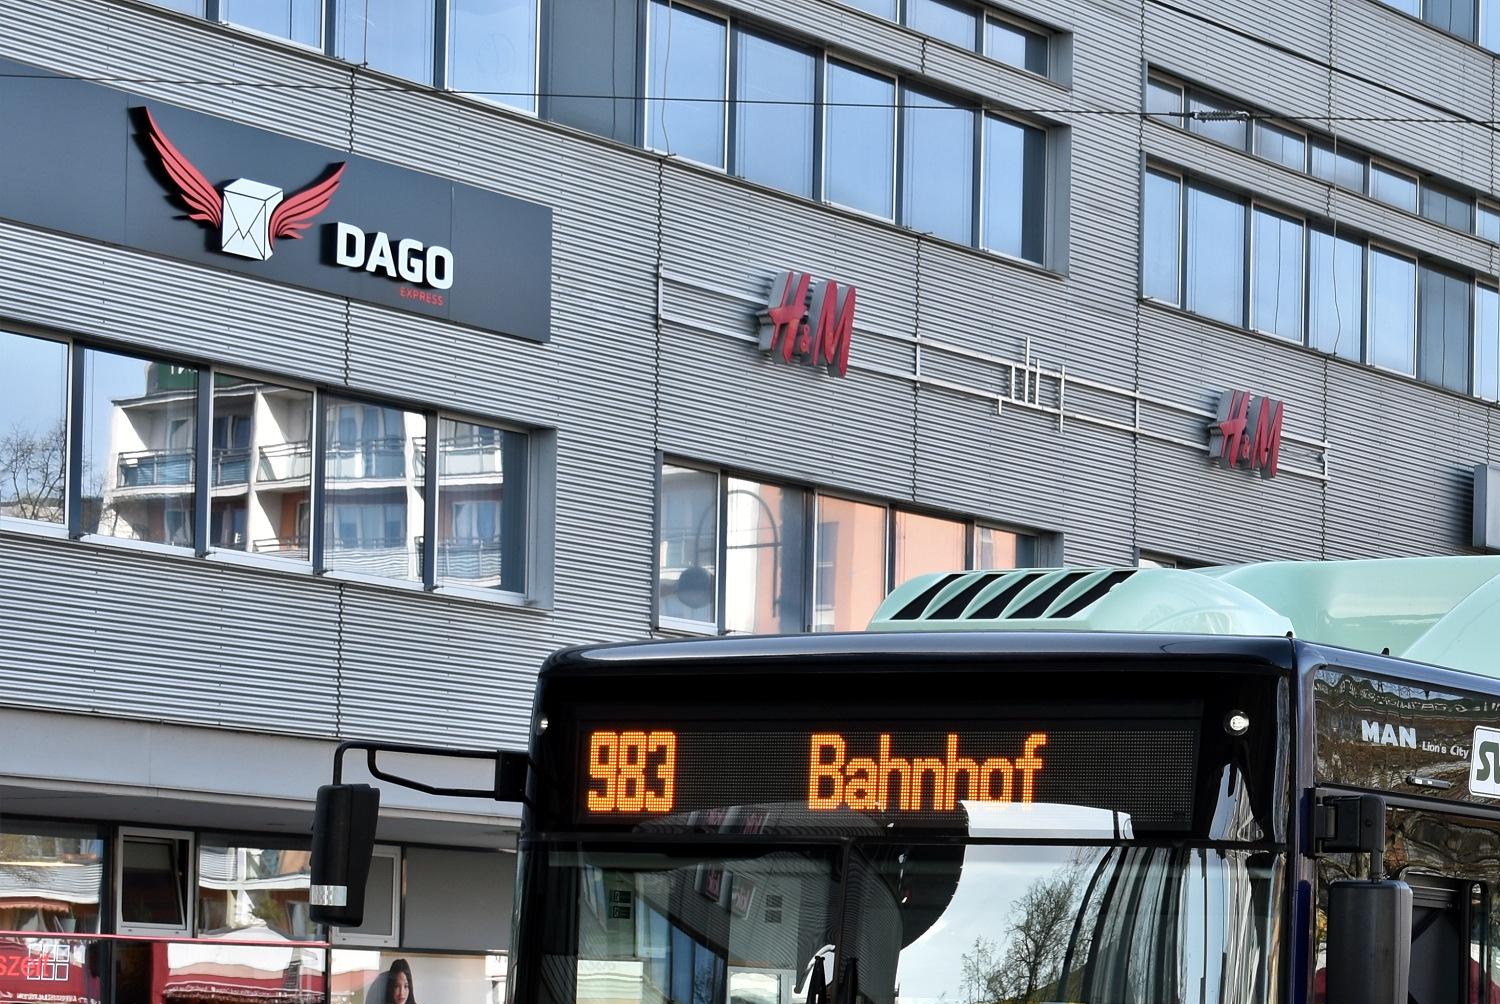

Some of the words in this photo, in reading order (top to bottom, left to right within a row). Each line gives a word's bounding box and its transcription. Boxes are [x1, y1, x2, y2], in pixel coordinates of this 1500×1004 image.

[337, 222, 454, 289] DAGO
[400, 287, 444, 306] EXPRESS
[768, 271, 856, 378] H&M
[1219, 389, 1284, 478] H&M
[588, 731, 676, 812] 983
[808, 734, 1047, 811] Bahnhof
[1361, 719, 1417, 749] MAN
[1422, 741, 1447, 754] Lion's
[1450, 745, 1469, 760] City
